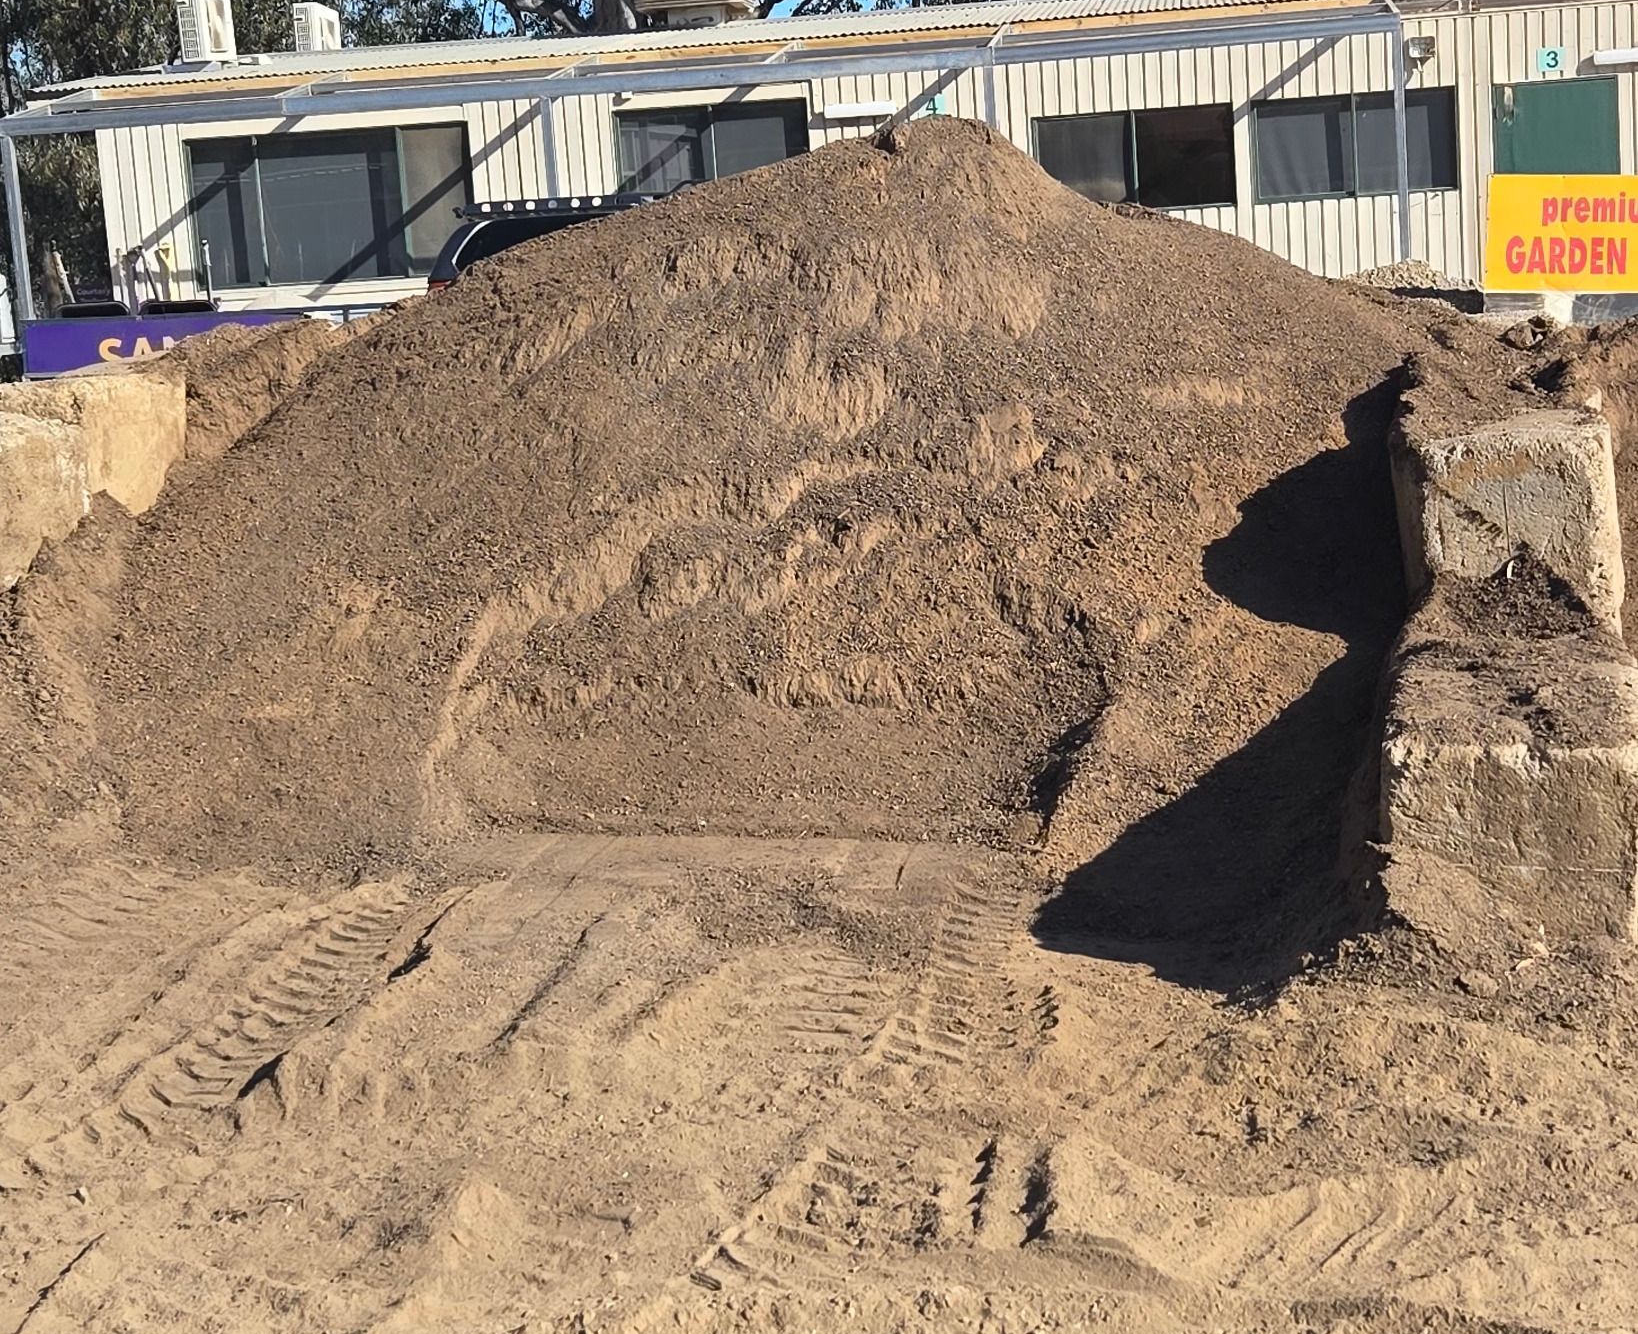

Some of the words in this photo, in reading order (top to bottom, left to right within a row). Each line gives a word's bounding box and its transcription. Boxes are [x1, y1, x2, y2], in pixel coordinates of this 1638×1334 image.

[1546, 50, 1558, 68] 3
[925, 97, 938, 115] 4
[1505, 235, 1627, 274] GARDEN
